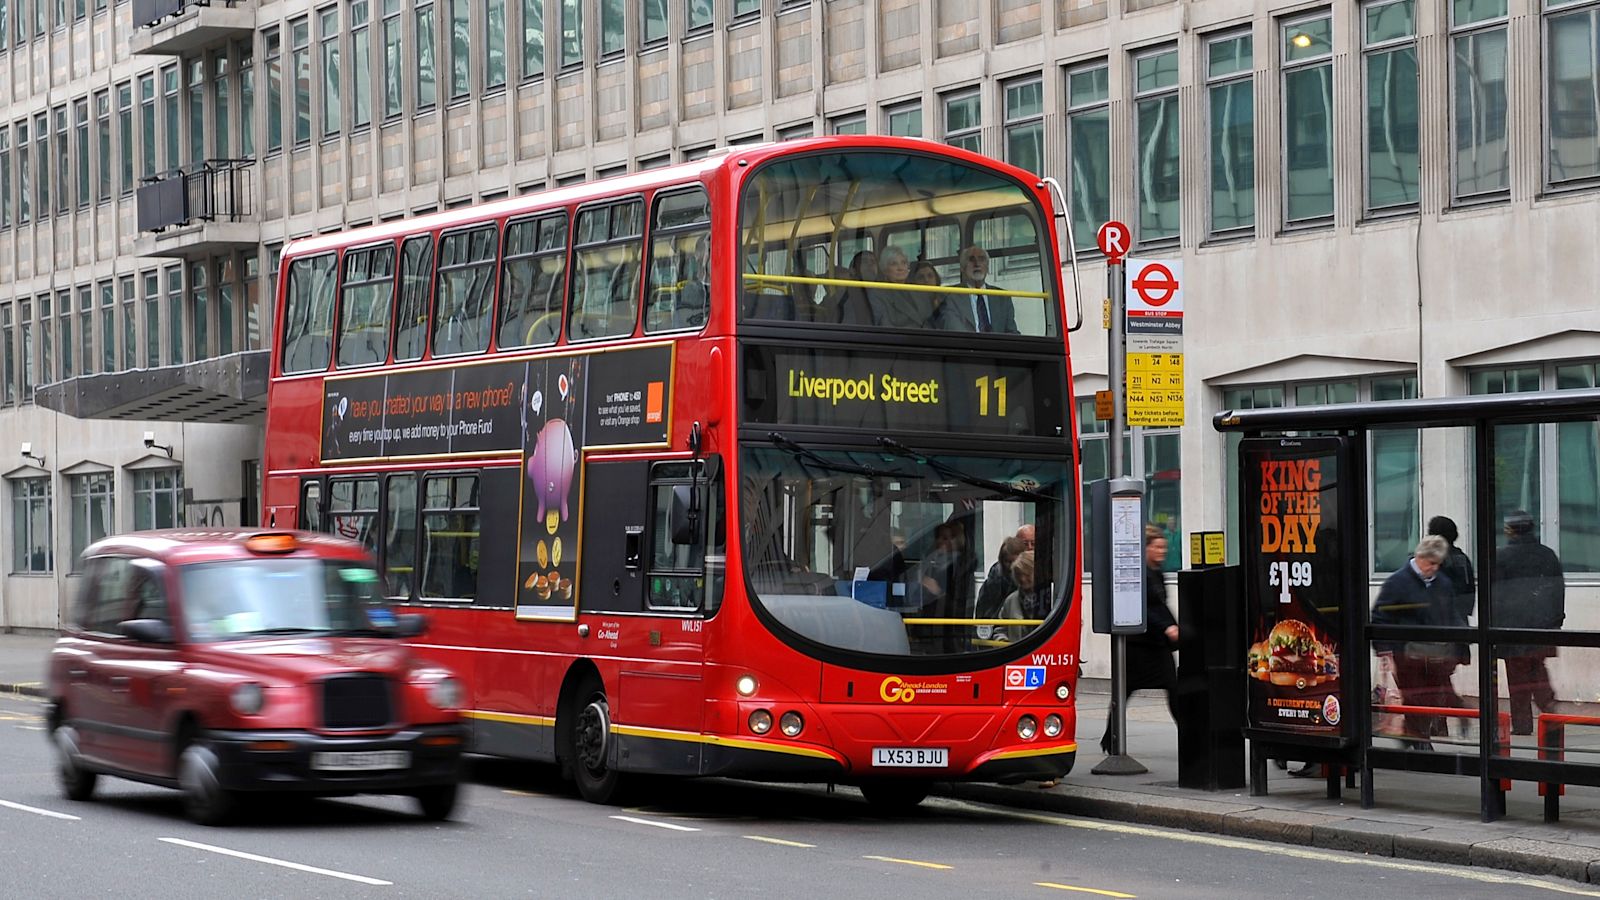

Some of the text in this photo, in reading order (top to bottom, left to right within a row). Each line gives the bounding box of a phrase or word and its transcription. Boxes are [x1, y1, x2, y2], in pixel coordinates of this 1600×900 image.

[1105, 226, 1124, 253] R
[1165, 322, 1181, 330] Abbey
[1152, 358, 1160, 366] 24
[1169, 358, 1180, 366] 148
[1132, 376, 1142, 384] 211
[1151, 377, 1161, 385] N2
[1170, 377, 1180, 385] N11
[789, 369, 939, 405] Liverpool Street
[350, 398, 367, 418] have
[368, 400, 381, 421] you
[411, 395, 428, 418] your
[429, 394, 445, 416] way
[455, 392, 461, 410] a
[463, 391, 481, 410] new
[481, 382, 514, 412] phone?
[613, 391, 629, 402] PHONE
[975, 375, 1007, 417] 11
[1150, 395, 1163, 403] N52
[1167, 394, 1183, 402] N136
[349, 418, 492, 445] every time you top up, we add money to your Phone Fund
[1261, 459, 1321, 491] KING
[1261, 491, 1320, 514] OF THE
[1261, 515, 1321, 553] DAY
[1269, 561, 1312, 603] £1.99
[681, 620, 702, 632] WVL151
[597, 629, 619, 640] Go-Ahead
[1031, 653, 1074, 666] WVL151
[880, 676, 915, 703] Go
[1273, 699, 1304, 707] DIFFERENT
[1305, 700, 1321, 709] DEAL
[1278, 709, 1309, 718] EVERY DAY
[878, 750, 942, 764] LX53 BJU
